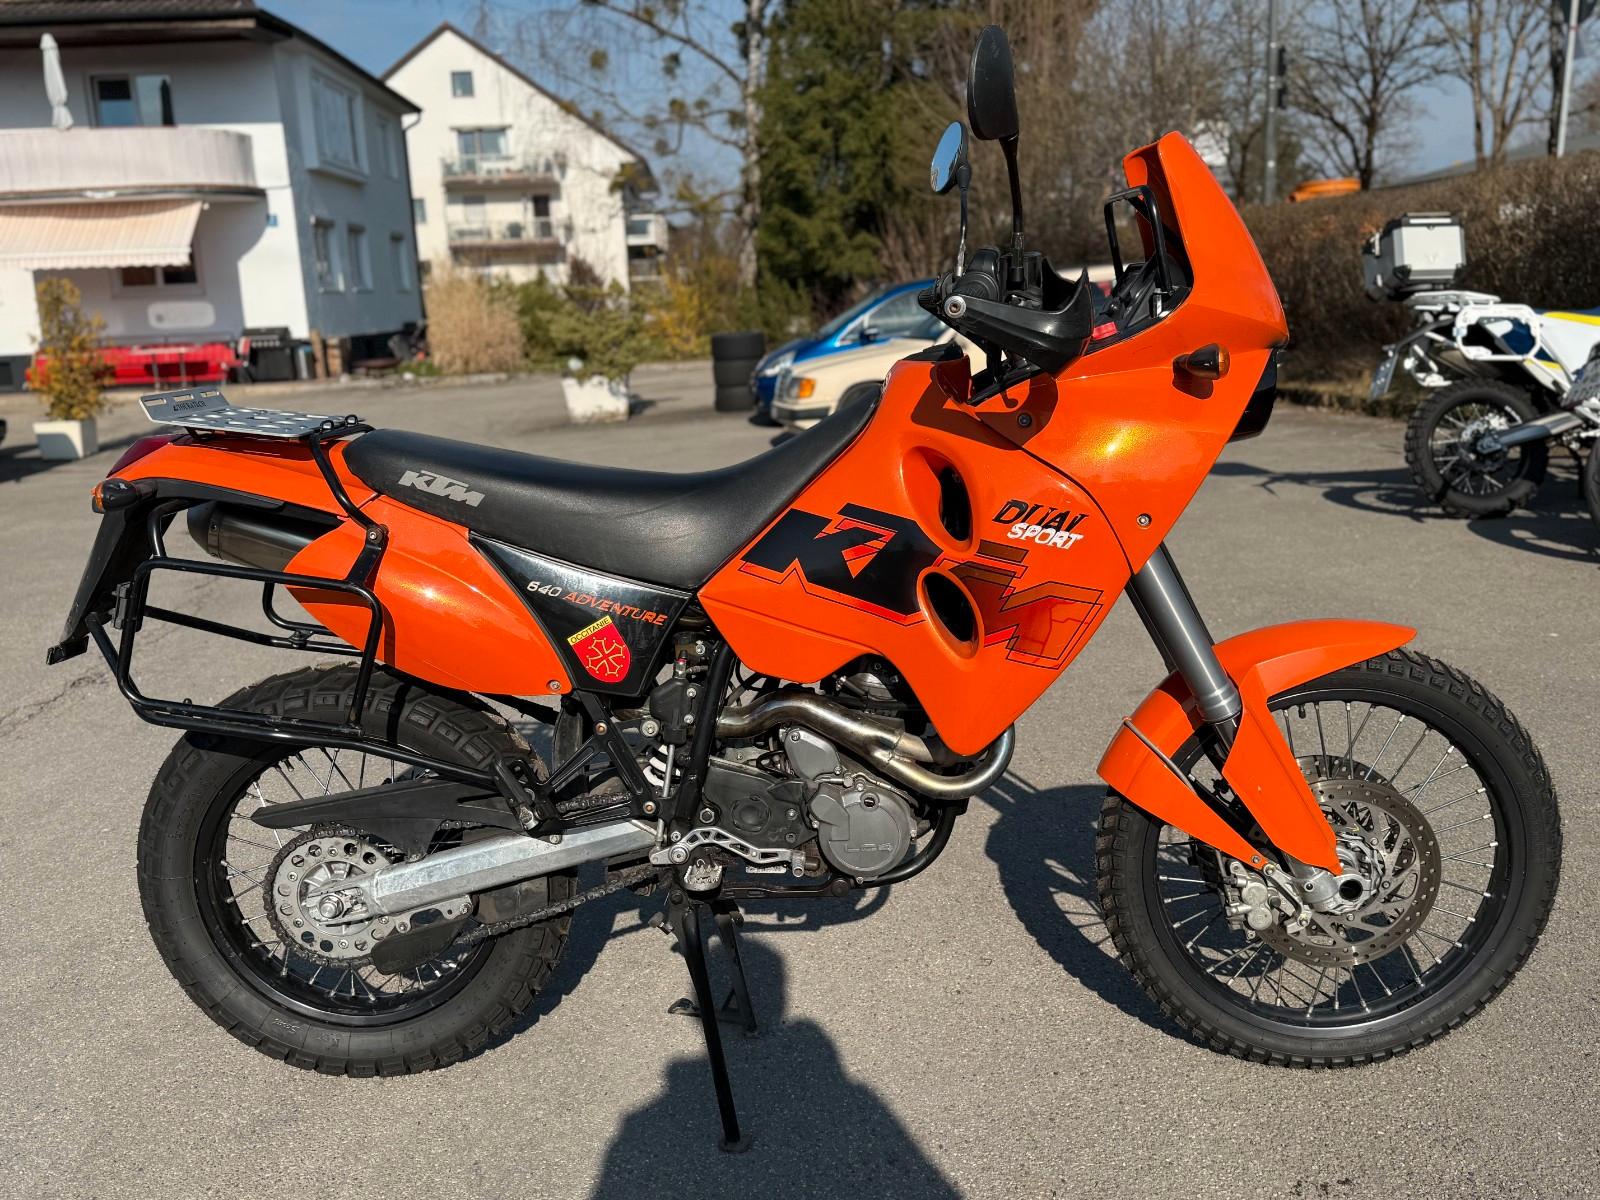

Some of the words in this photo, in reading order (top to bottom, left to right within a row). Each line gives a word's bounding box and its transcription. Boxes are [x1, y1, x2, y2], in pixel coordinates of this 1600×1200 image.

[398, 470, 486, 507] KTM
[992, 499, 1089, 532] DUAL
[1007, 522, 1085, 550] SPORT
[526, 580, 563, 597] 640
[562, 591, 670, 626] ADVENTURE
[570, 617, 610, 644] OCCITANIE
